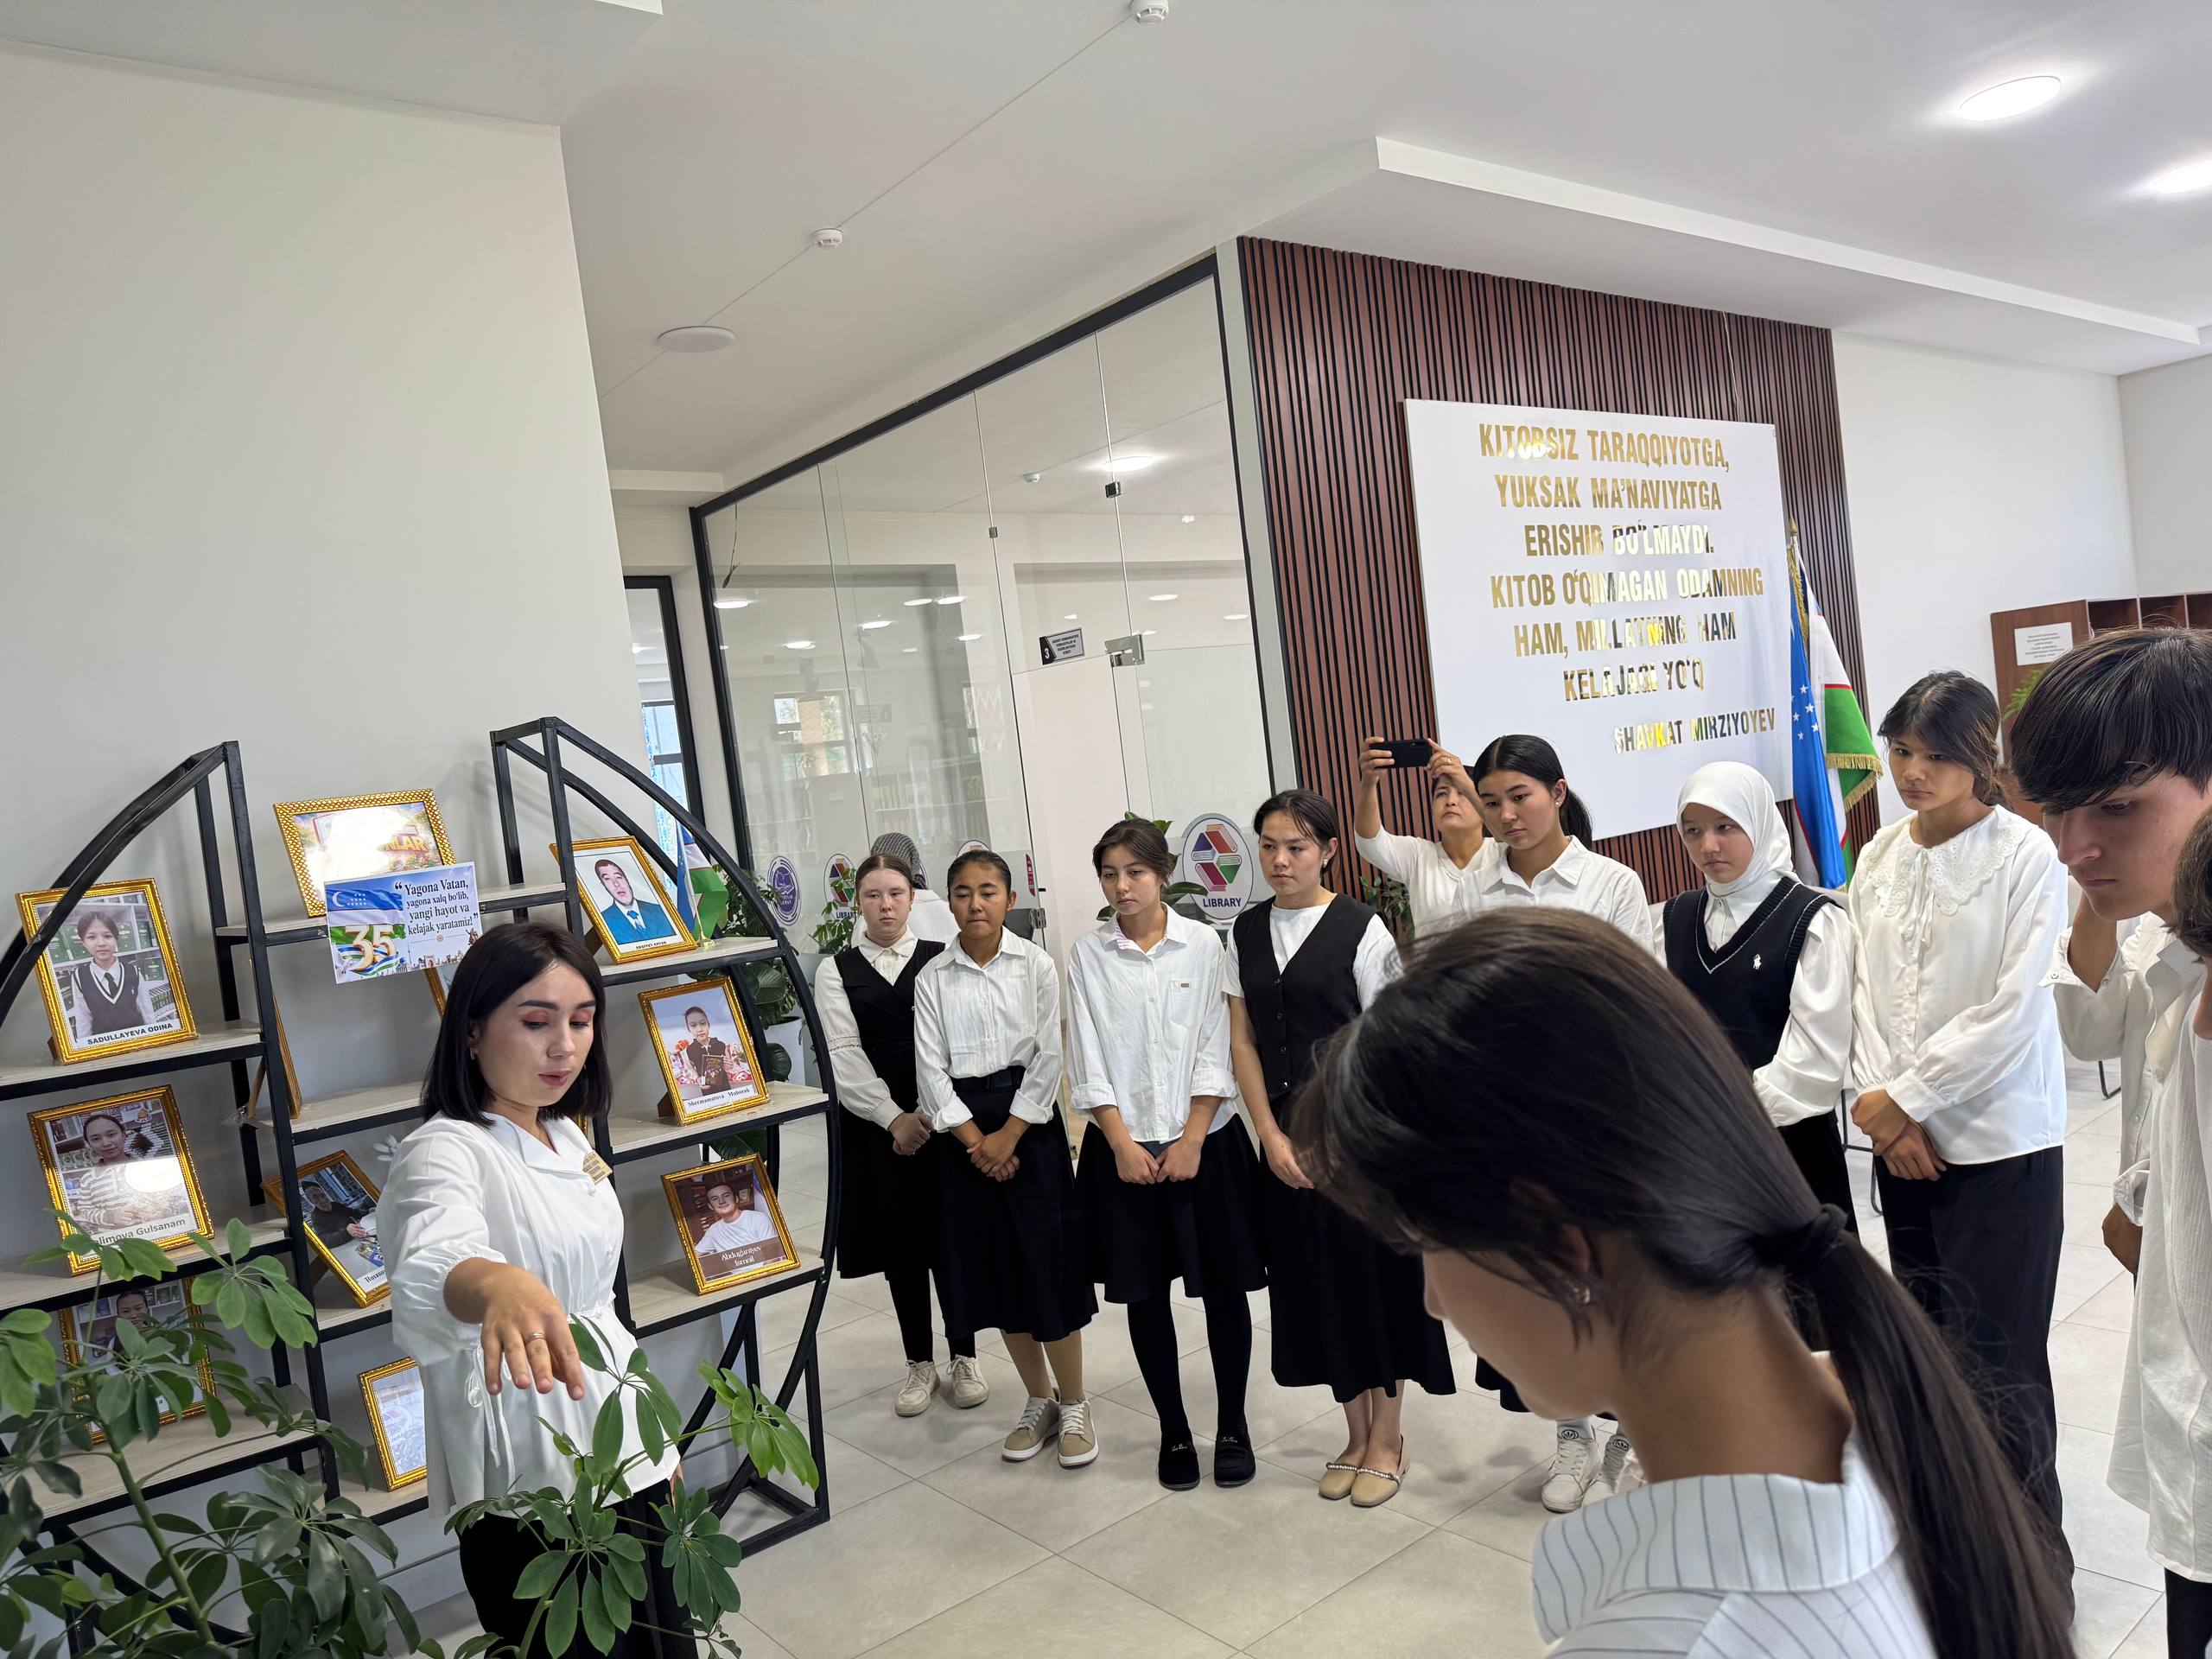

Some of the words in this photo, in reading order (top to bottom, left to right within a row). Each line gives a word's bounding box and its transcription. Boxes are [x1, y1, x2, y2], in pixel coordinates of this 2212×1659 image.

[1478, 423, 1579, 461] KITOBSIZ
[1586, 429, 1729, 473] TARAQQIYOTGA,
[1494, 474, 1581, 508] YUKSAK
[1524, 524, 1604, 556] ERISHIB
[1491, 573, 1555, 608] KITOB
[1675, 567, 1764, 599] ODAMNING
[1514, 622, 1568, 658] HAM,
[1575, 614, 1688, 652] MILLATNING
[1696, 611, 1737, 643] HAM
[1044, 647, 1050, 659] 3
[1562, 662, 1658, 702] KELAJAGI
[1613, 720, 1683, 754] SHAVKAT
[1690, 707, 1776, 742] MIRZIYOYEV
[440, 879, 468, 891] Vatan,
[406, 898, 431, 910] yagona
[432, 893, 447, 905] xalq
[409, 906, 433, 923] yangi
[435, 904, 458, 918] hayot
[460, 904, 470, 912] va
[1203, 897, 1242, 908] LIBRARY
[408, 921, 435, 935] kelajak
[345, 924, 397, 970] 35
[86, 1028, 146, 1046] SADULLAYEVA
[148, 1022, 173, 1033] ODINA
[136, 1218, 186, 1236] Gulsanam
